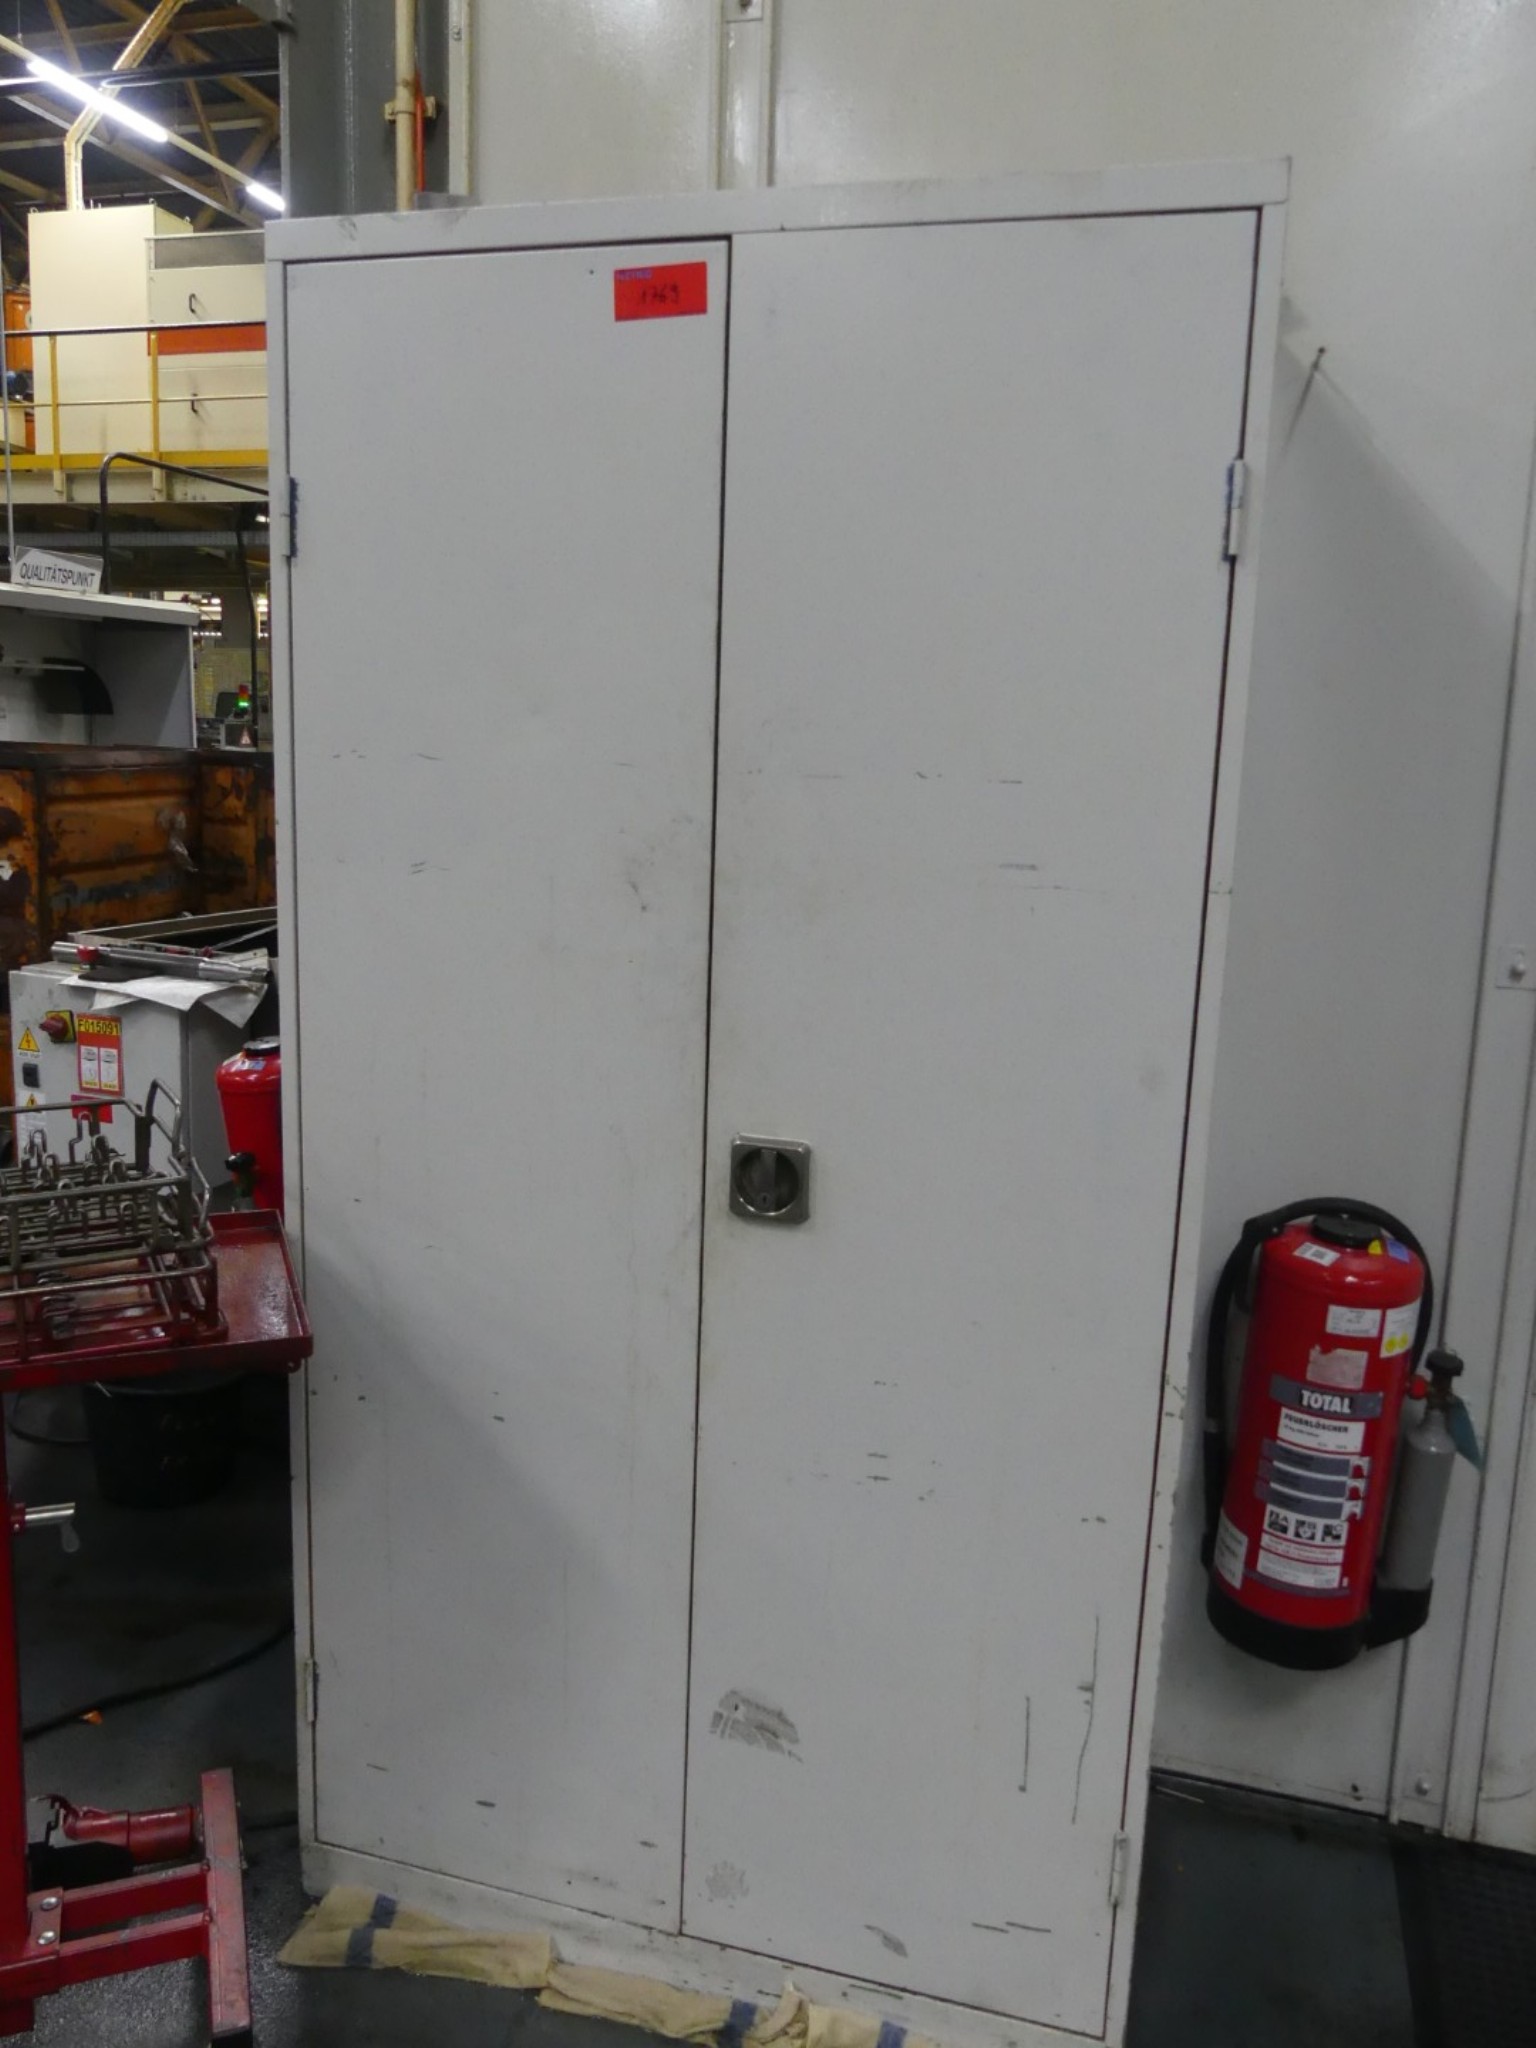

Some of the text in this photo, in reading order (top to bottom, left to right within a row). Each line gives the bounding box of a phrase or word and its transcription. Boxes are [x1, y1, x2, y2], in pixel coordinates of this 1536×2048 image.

[19, 562, 96, 588] QUALITÄTSPUNKT
[77, 1018, 121, 1036] F015091
[1301, 1389, 1352, 1414] TOTAL
